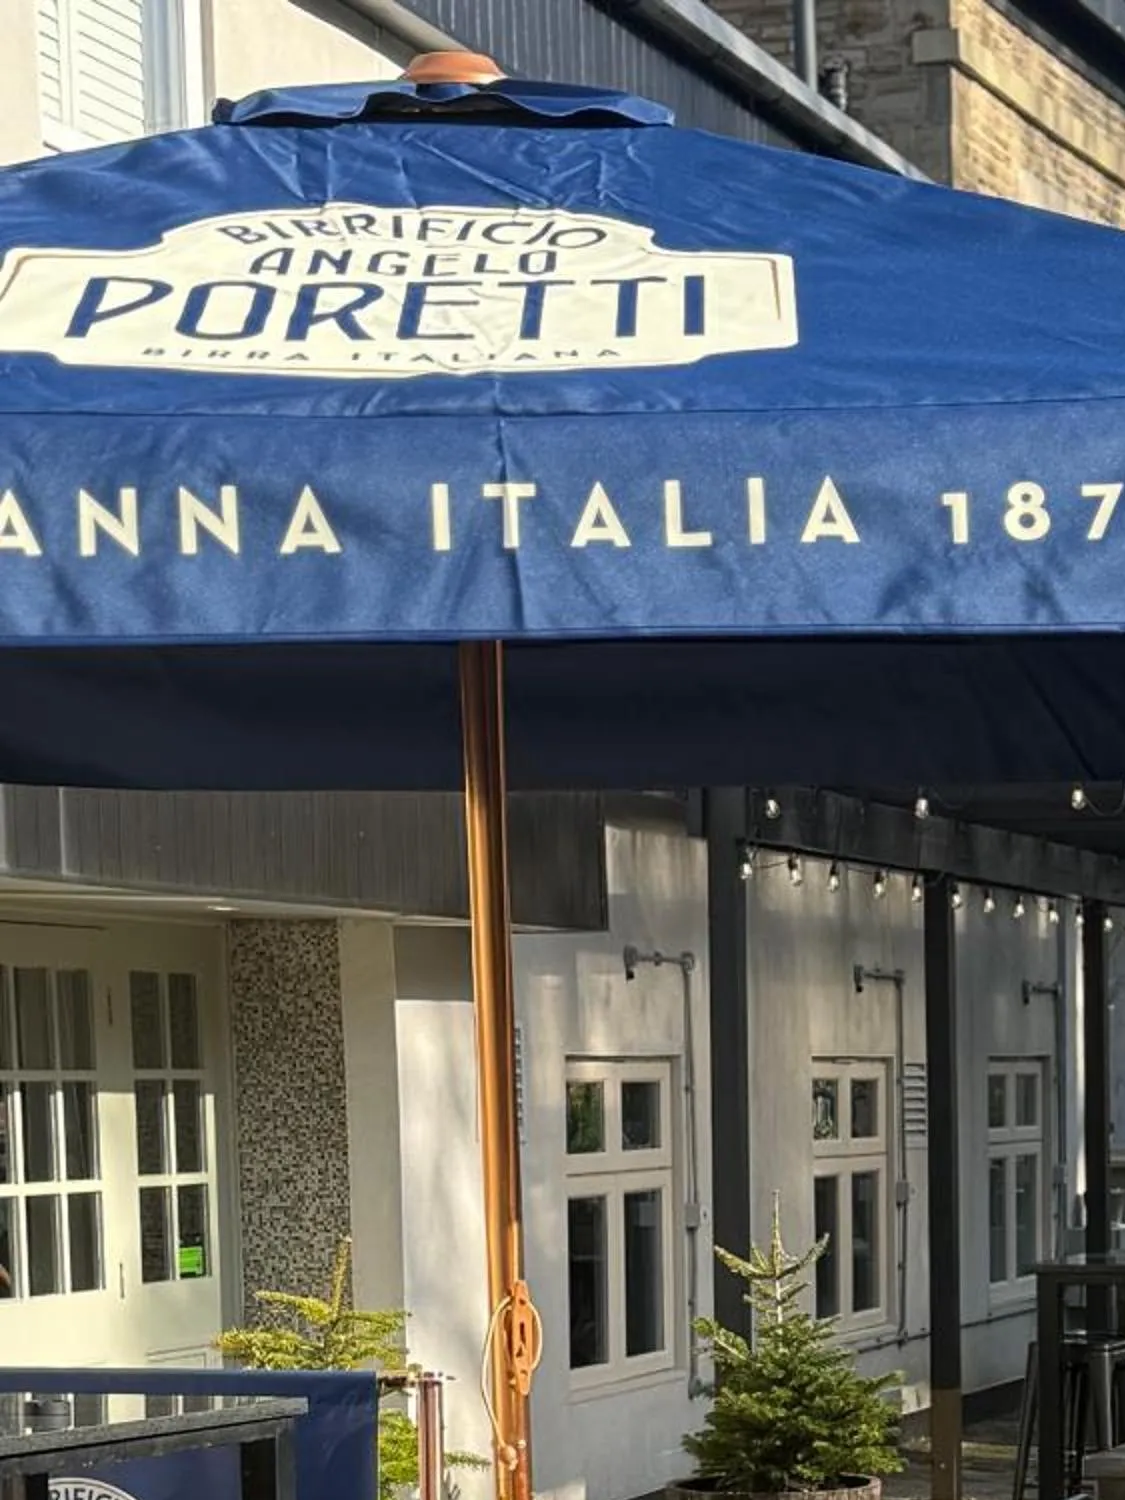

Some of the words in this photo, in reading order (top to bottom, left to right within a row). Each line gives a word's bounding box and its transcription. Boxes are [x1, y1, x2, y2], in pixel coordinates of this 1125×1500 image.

[216, 213, 607, 249] BIRRIFICIO
[250, 247, 557, 277] ANGELO
[64, 274, 705, 341] PORETTI
[141, 347, 310, 361] BIRRA
[350, 349, 620, 362] ITALIANA
[431, 475, 862, 552] ITALIA
